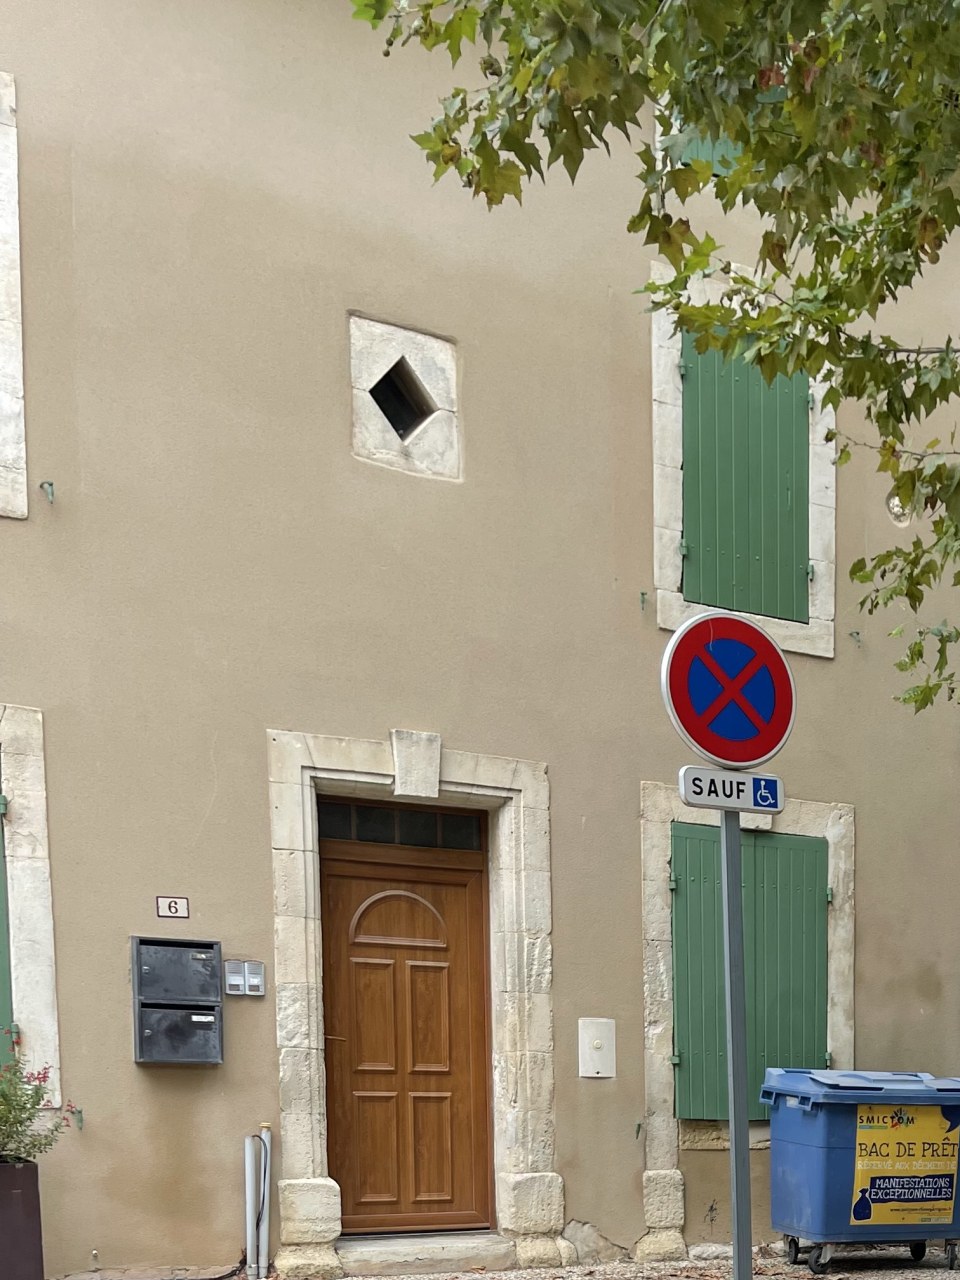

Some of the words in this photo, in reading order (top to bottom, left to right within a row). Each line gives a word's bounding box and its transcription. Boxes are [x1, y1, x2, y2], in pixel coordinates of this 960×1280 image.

[692, 777, 746, 799] SAUF
[168, 900, 178, 915] 6
[859, 1115, 915, 1125] SMICTOM
[858, 1142, 890, 1158] BAC
[896, 1142, 917, 1158] DE
[922, 1136, 959, 1158] PRÊT
[857, 1159, 893, 1169] RÉSERVÉ
[895, 1161, 910, 1169] AUX
[875, 1178, 950, 1188] MANIFESTATIONS
[871, 1188, 952, 1199] EXCEPTIONNELLES
